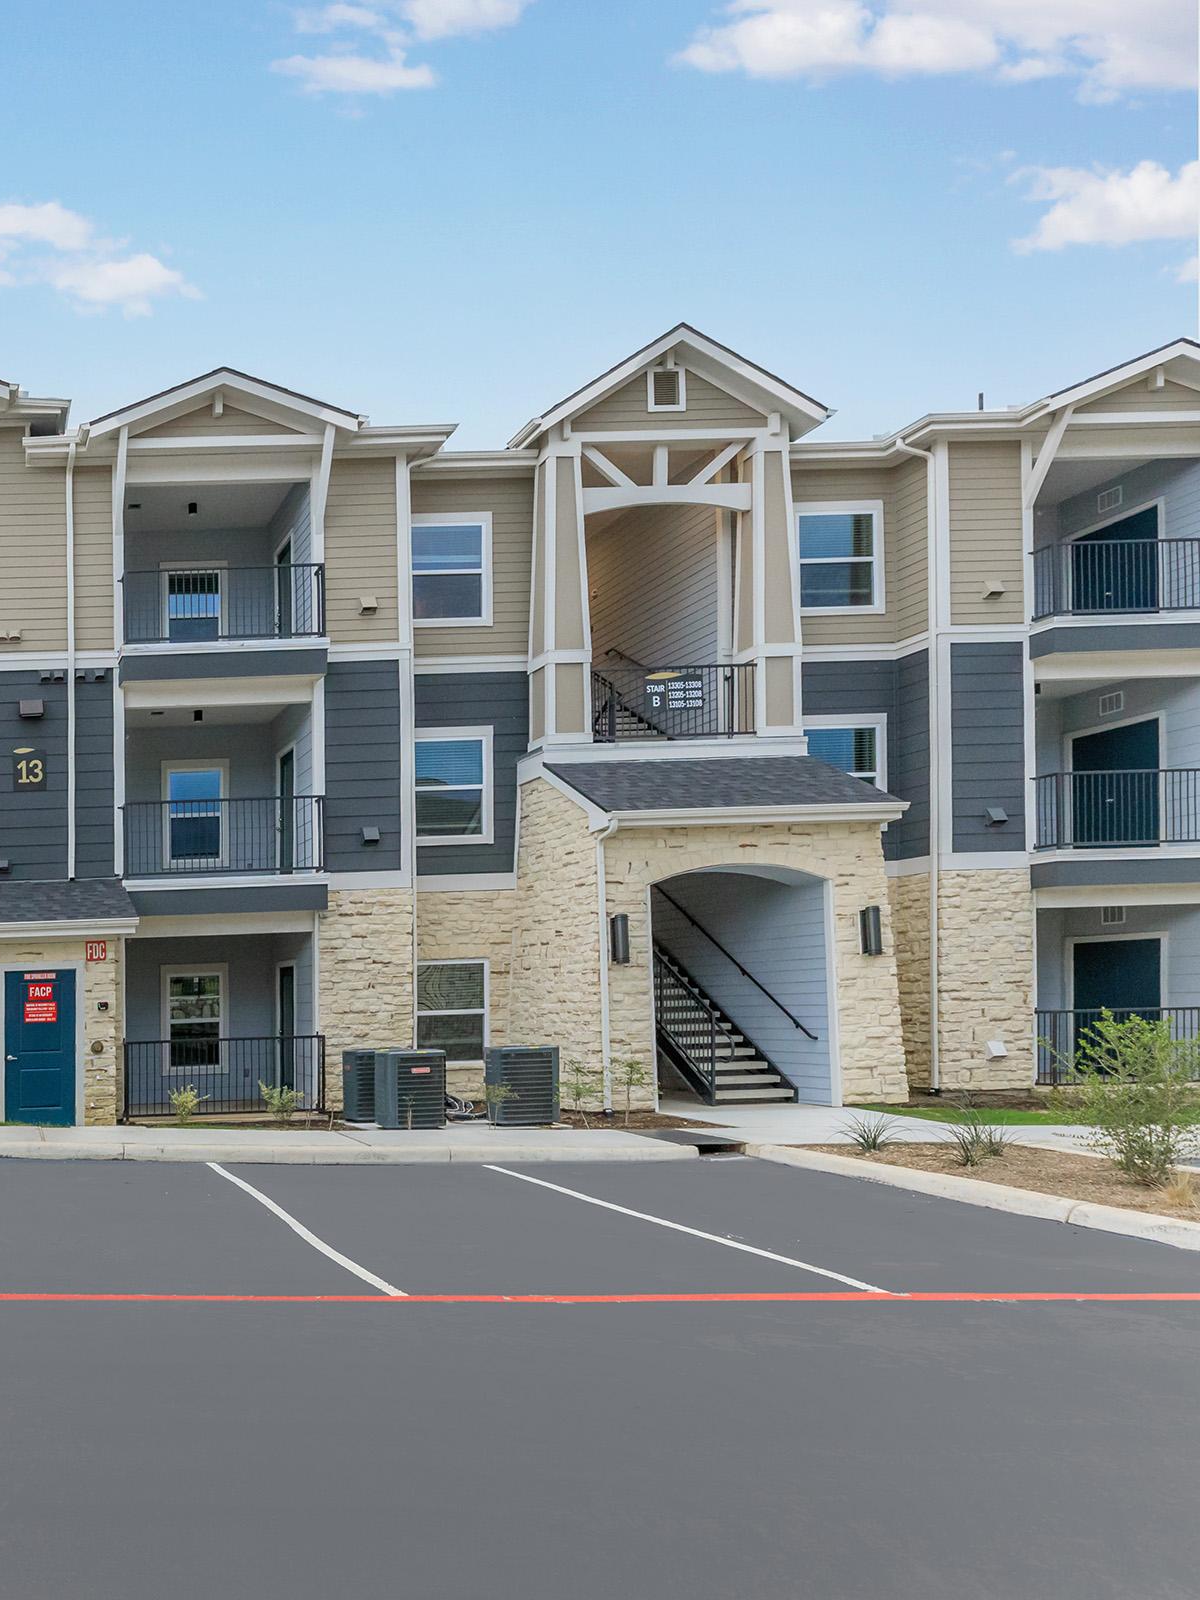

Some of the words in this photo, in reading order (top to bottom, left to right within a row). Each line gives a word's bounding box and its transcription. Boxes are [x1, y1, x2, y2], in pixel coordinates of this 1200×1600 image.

[646, 685, 665, 693] STAIR
[652, 696, 661, 707] B
[17, 759, 43, 783] 13
[87, 942, 105, 959] FDC
[29, 986, 52, 997] FACP
